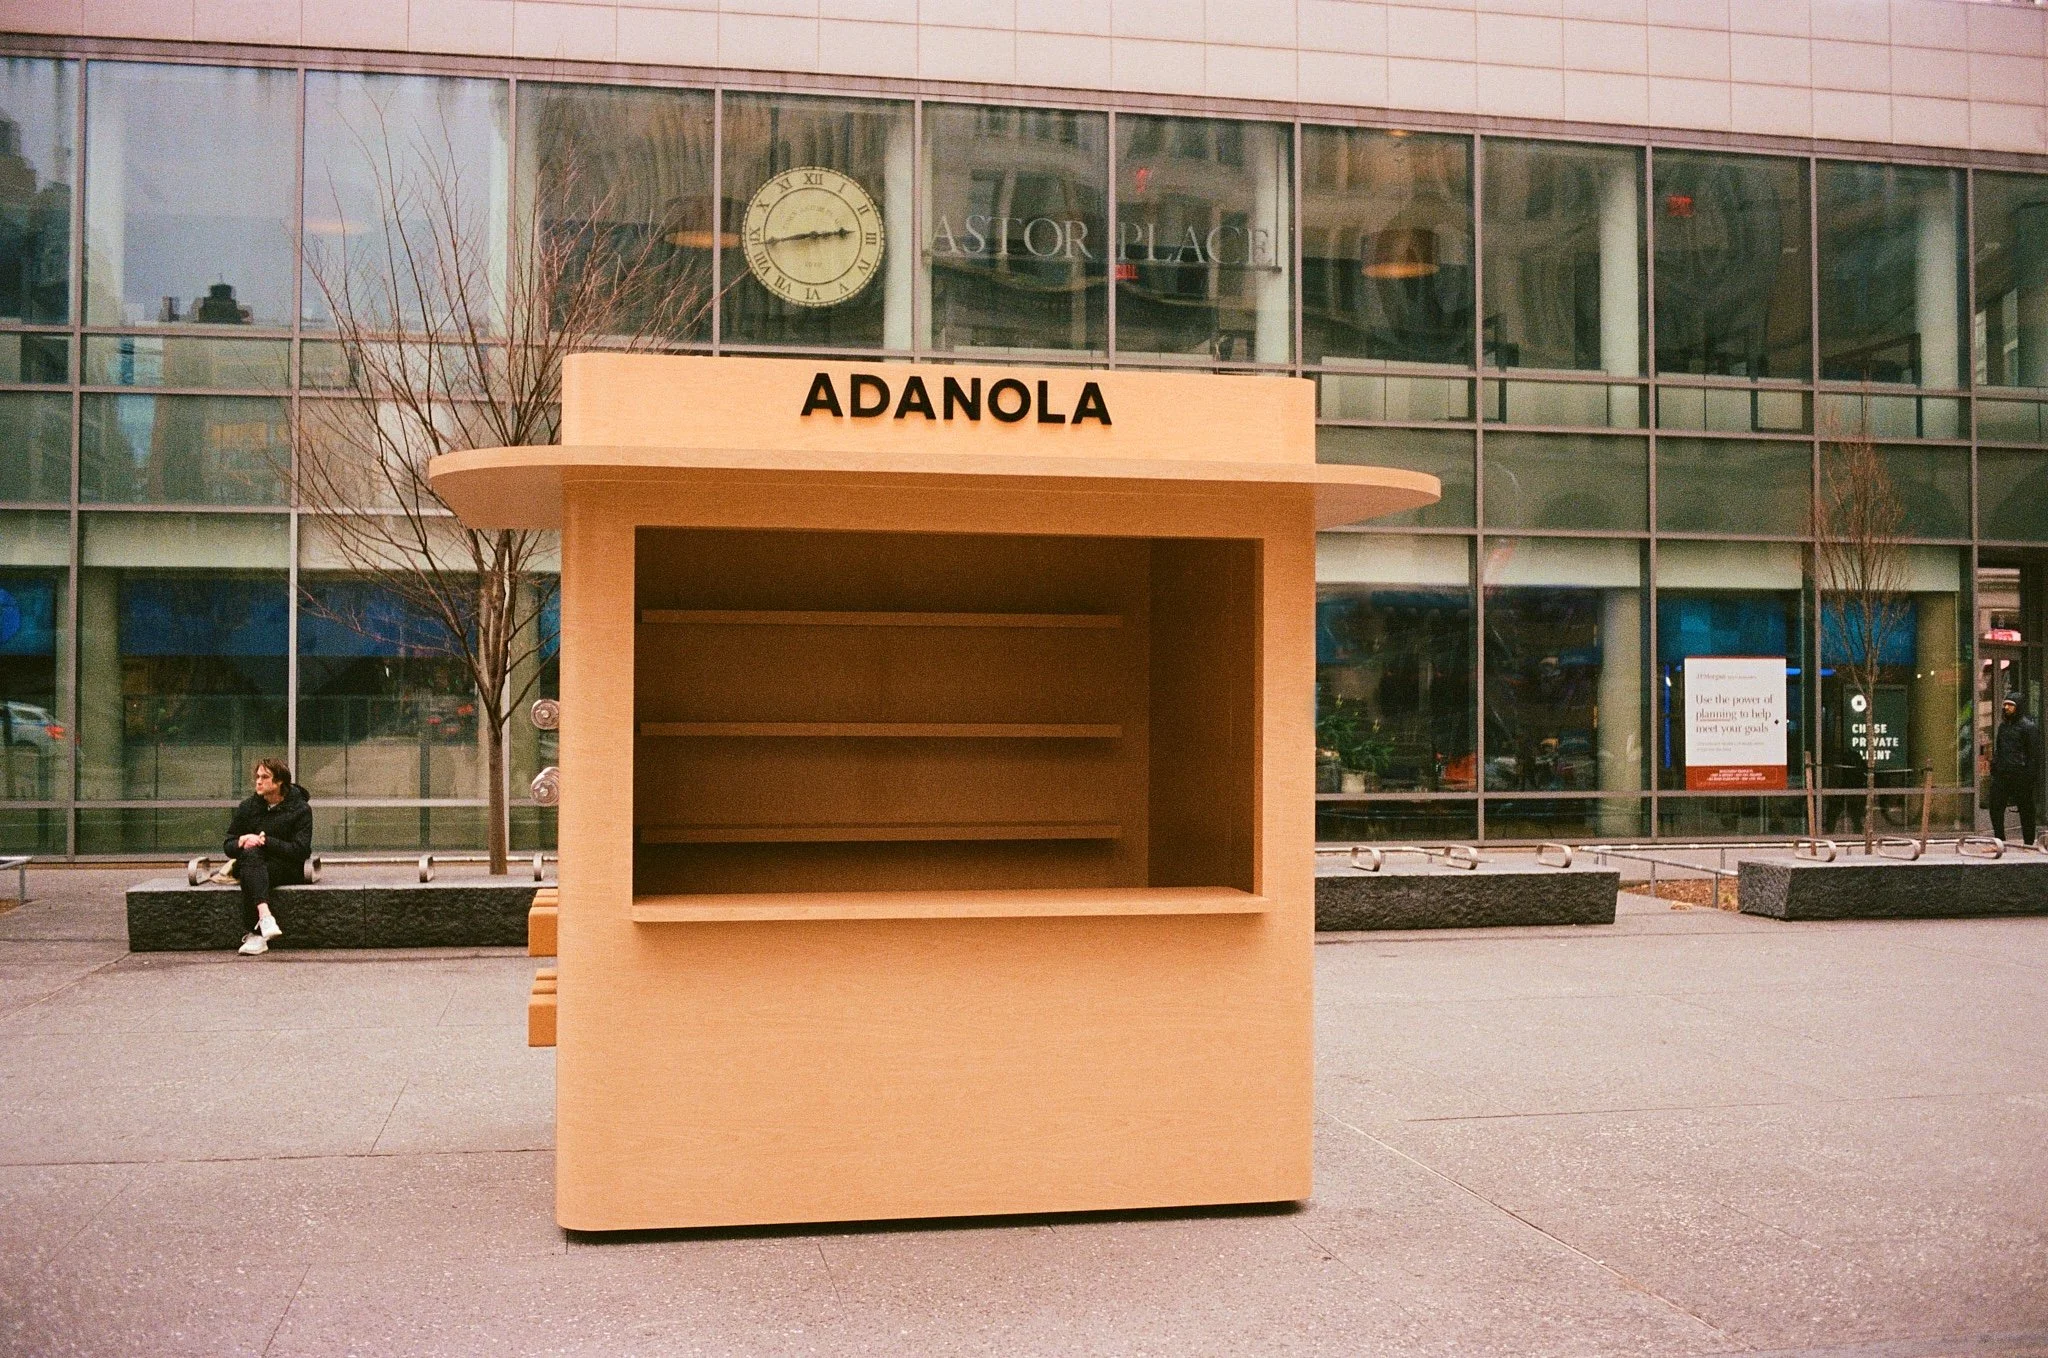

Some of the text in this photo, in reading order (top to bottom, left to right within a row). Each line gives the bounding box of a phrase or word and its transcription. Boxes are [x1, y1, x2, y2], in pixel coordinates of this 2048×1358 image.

[804, 173, 823, 185] XII
[756, 199, 770, 213] X
[857, 204, 870, 215] II
[866, 232, 877, 245] III
[930, 214, 1273, 265] ASTOR PLACE
[753, 251, 770, 273] VIII
[774, 276, 791, 294] VII
[839, 282, 850, 294] V
[806, 287, 821, 300] VI
[800, 373, 1112, 425] ADANOLA
[1695, 694, 1773, 706] Use the power of
[1696, 708, 1772, 721] planning to help
[1695, 722, 1769, 736] meet your goals
[1852, 723, 1888, 734] CHSE
[1852, 737, 1899, 747] PRVATE
[1855, 750, 1891, 760] LINT
